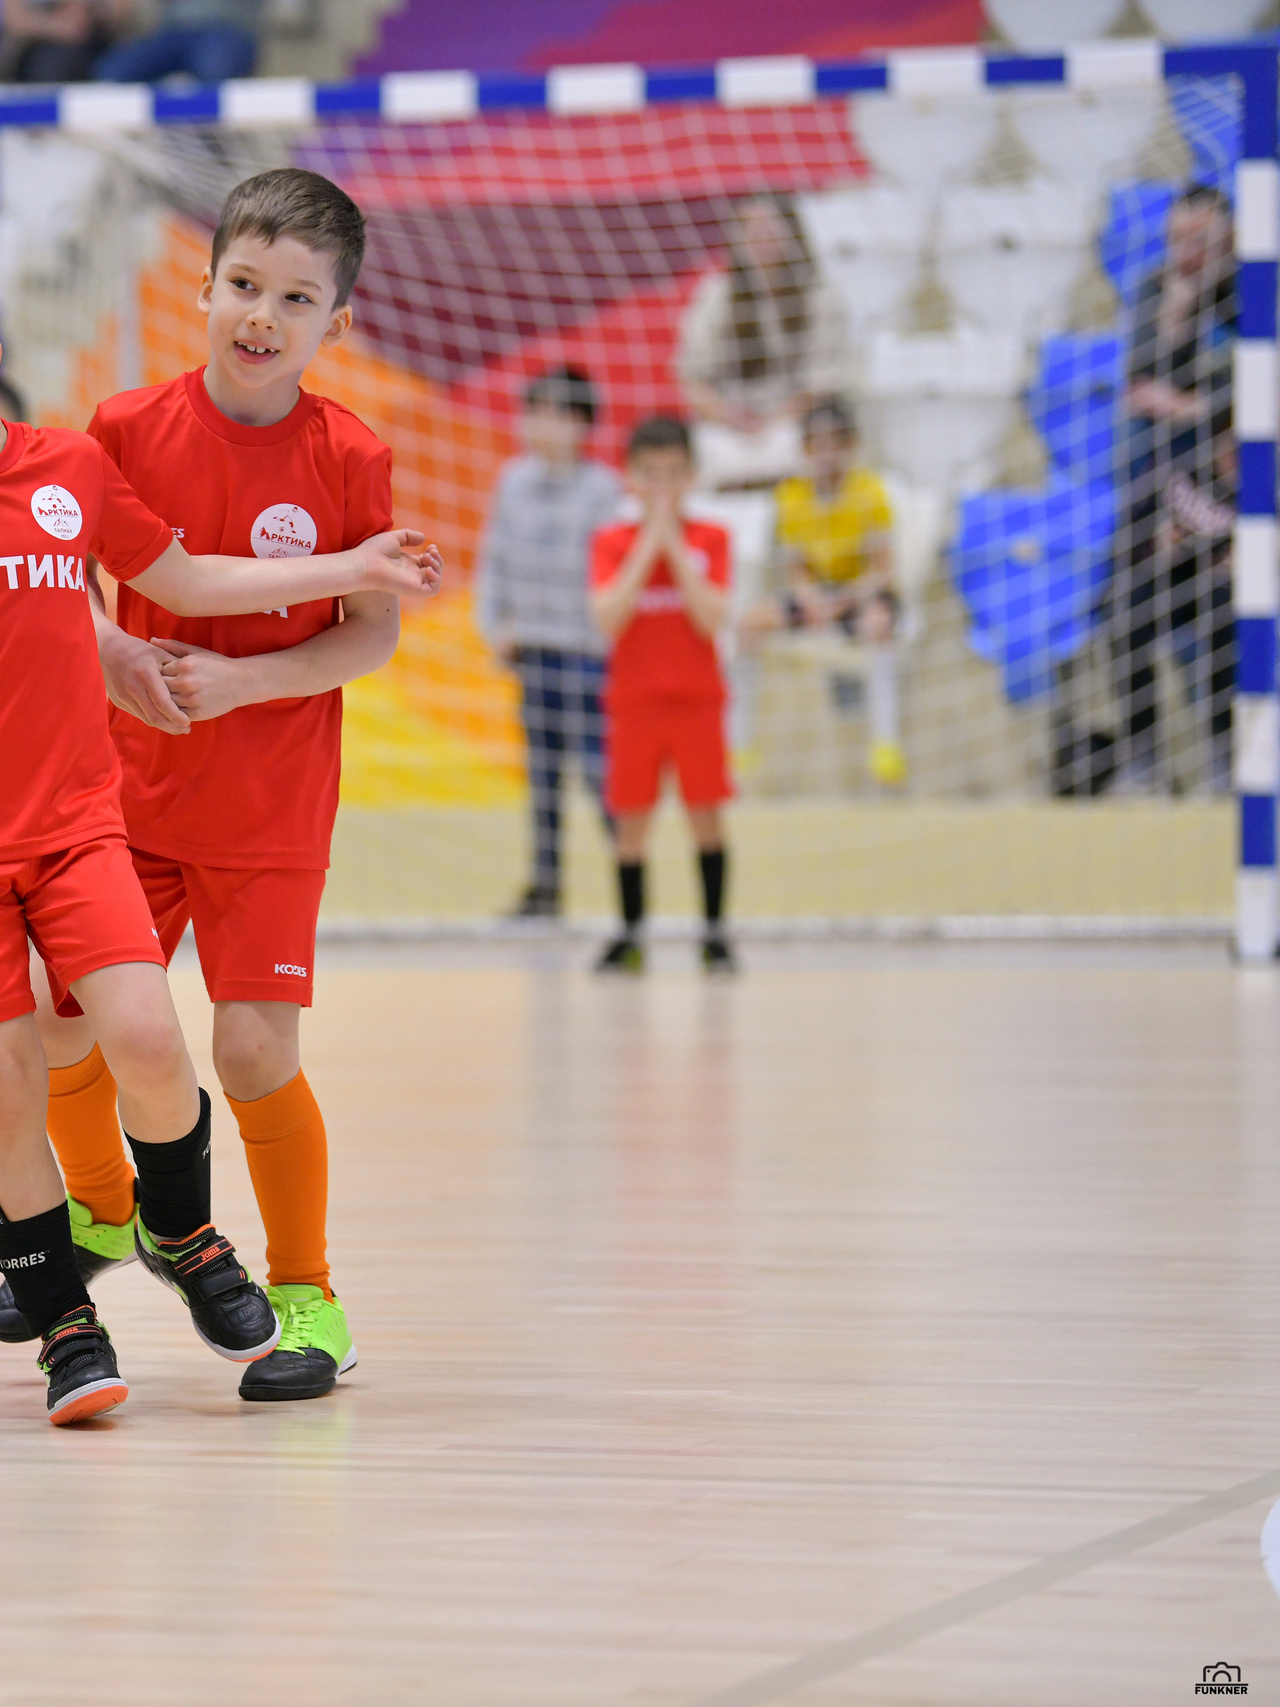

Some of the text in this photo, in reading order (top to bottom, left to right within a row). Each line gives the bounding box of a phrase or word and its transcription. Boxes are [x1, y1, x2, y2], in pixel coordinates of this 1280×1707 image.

[36, 506, 79, 516] АРКТИКА
[258, 526, 312, 549] АРКТИКА
[274, 963, 308, 978] KODES
